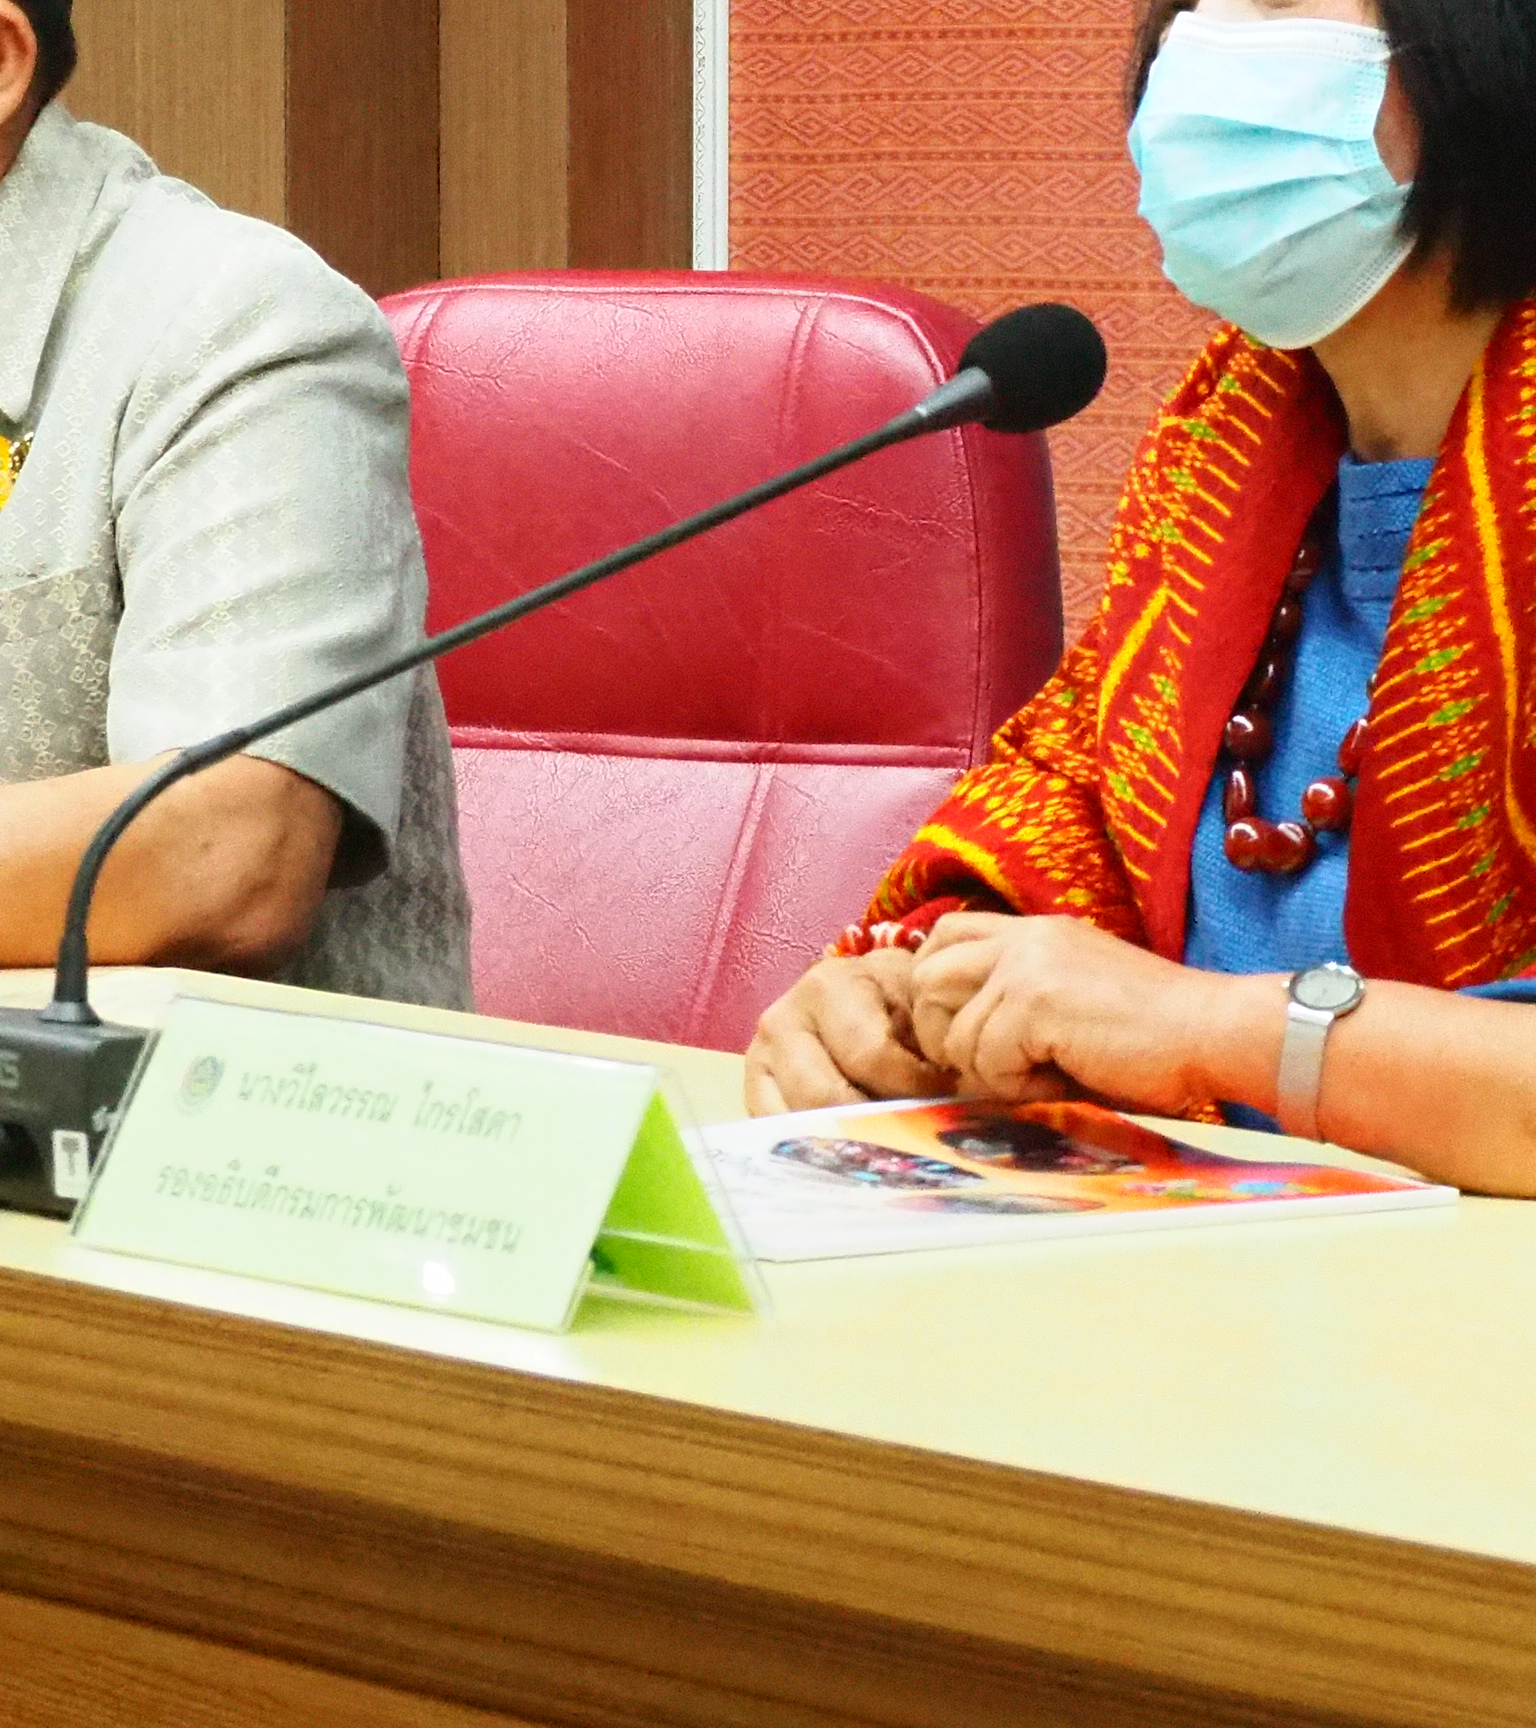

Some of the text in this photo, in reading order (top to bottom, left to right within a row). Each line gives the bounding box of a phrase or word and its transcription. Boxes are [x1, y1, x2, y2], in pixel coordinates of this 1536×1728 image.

[153, 1157, 526, 1255] รองอธิบดีกรมการพัฒนาชุมชน
